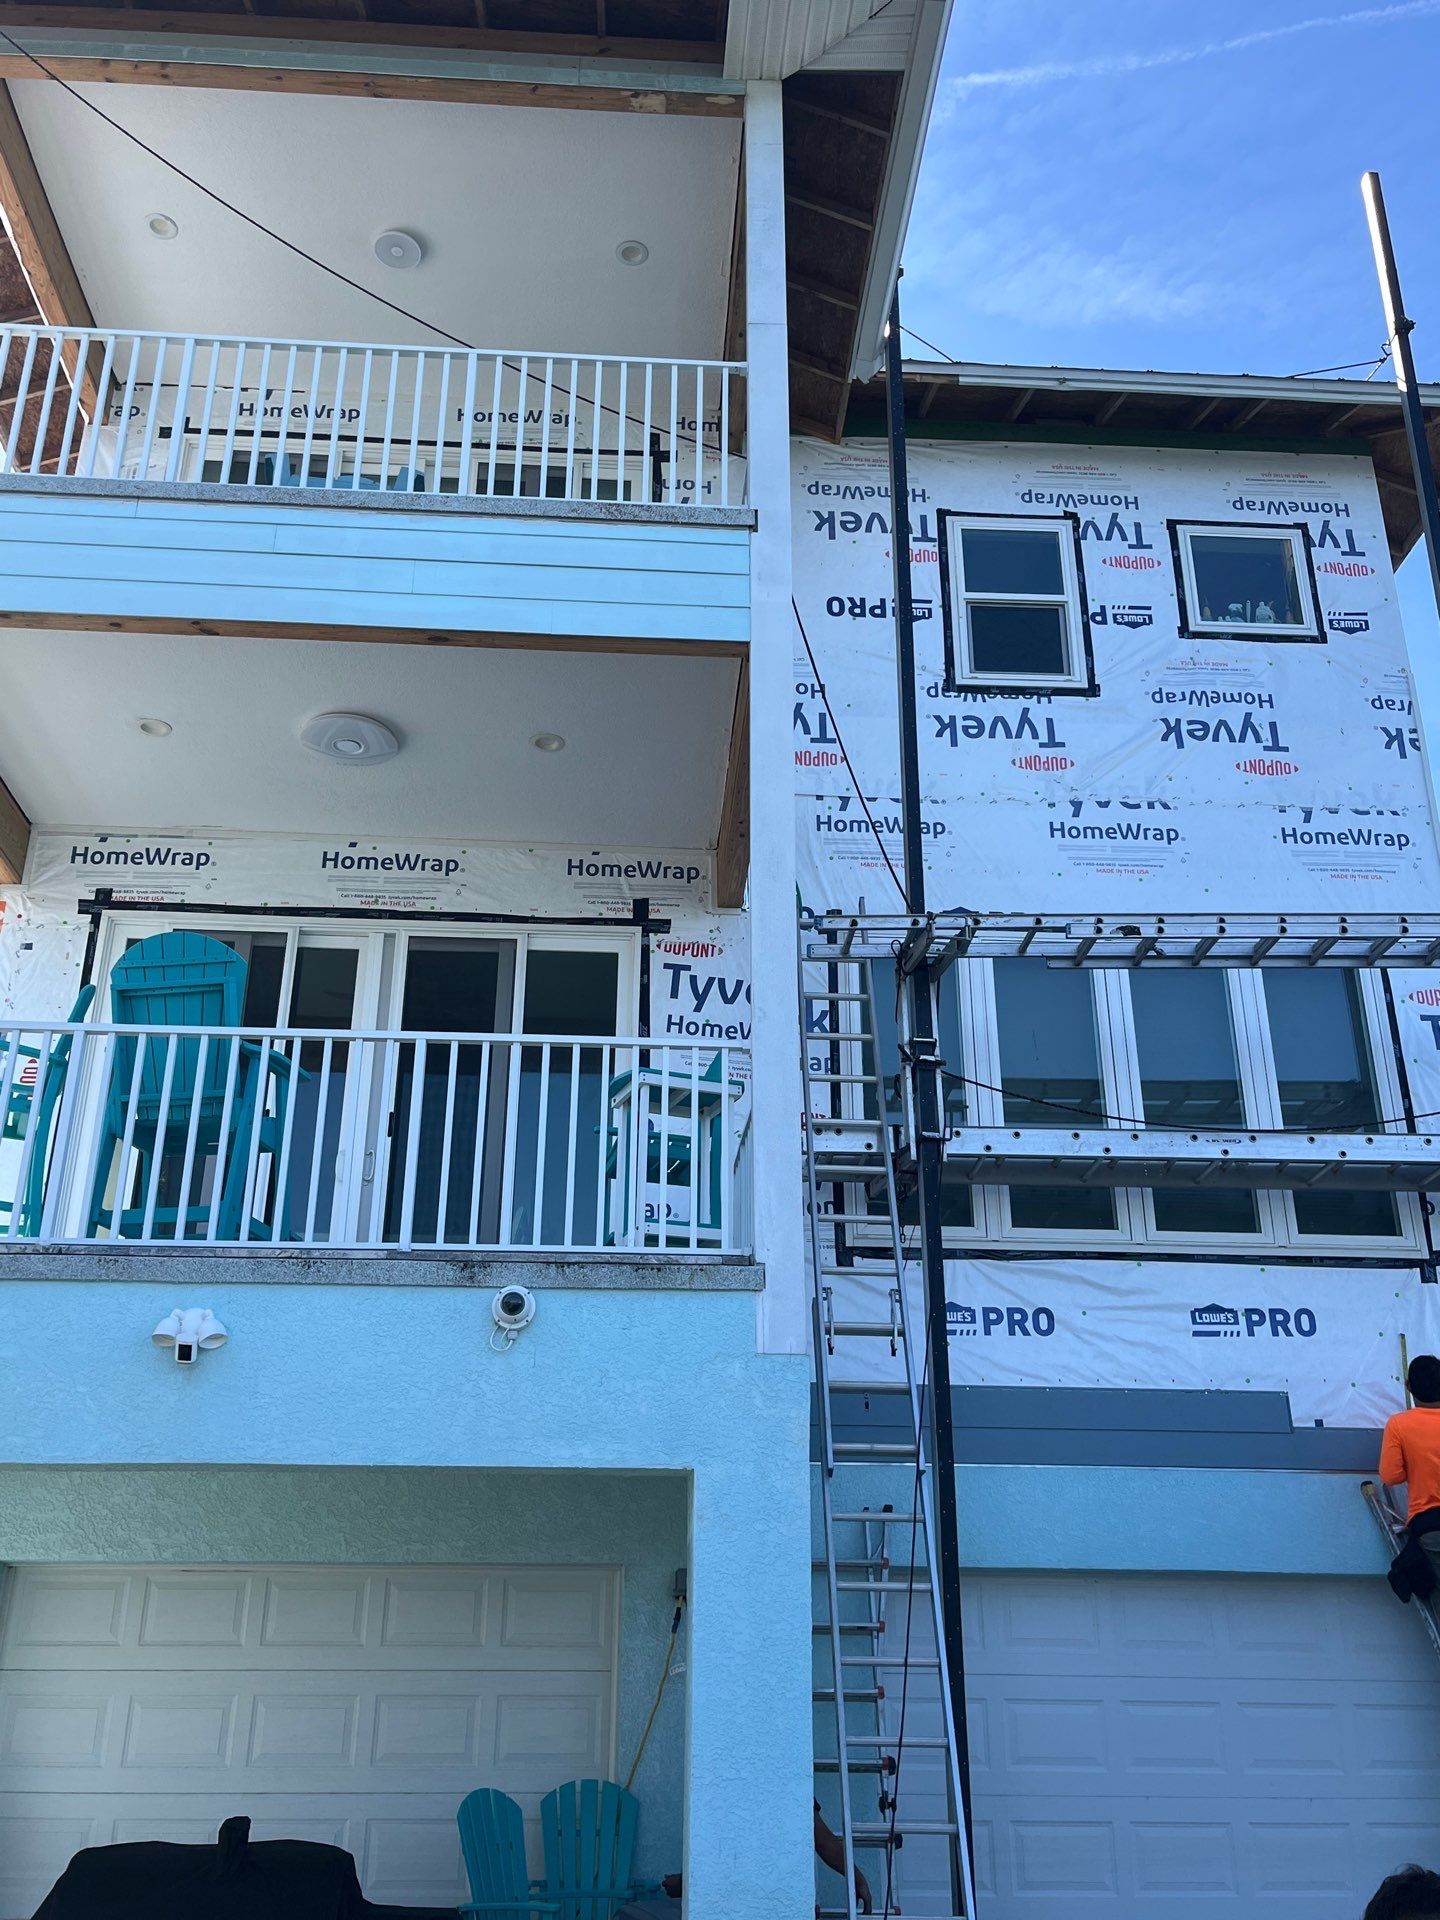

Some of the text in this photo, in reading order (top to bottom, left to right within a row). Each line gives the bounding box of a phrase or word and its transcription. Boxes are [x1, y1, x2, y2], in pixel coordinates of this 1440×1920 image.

[457, 408, 577, 427] HomeWap
[806, 483, 927, 503] HmeWrap
[1020, 489, 1140, 511] HomeWrap
[1232, 496, 1350, 518] HomeWrap
[826, 596, 887, 619] PRO
[1151, 687, 1275, 709] HomeWrap
[932, 707, 1066, 748] Tyvek
[1159, 711, 1290, 753] Tyvek
[1018, 754, 1068, 771] DUPONT
[1242, 758, 1292, 776] DUPONT
[816, 814, 946, 839] HomeWap
[1049, 821, 1180, 845] HomeWrap
[1281, 827, 1410, 851] HomeWrap
[70, 845, 211, 871] HomeWrap
[321, 851, 460, 877] HomeWrap
[567, 858, 700, 884] HomeWrap
[663, 940, 717, 958] DUPONT
[662, 962, 751, 1013] Tyv
[982, 1306, 1055, 1337] PRO
[1195, 1307, 1317, 1338] LOWE'S PRO
